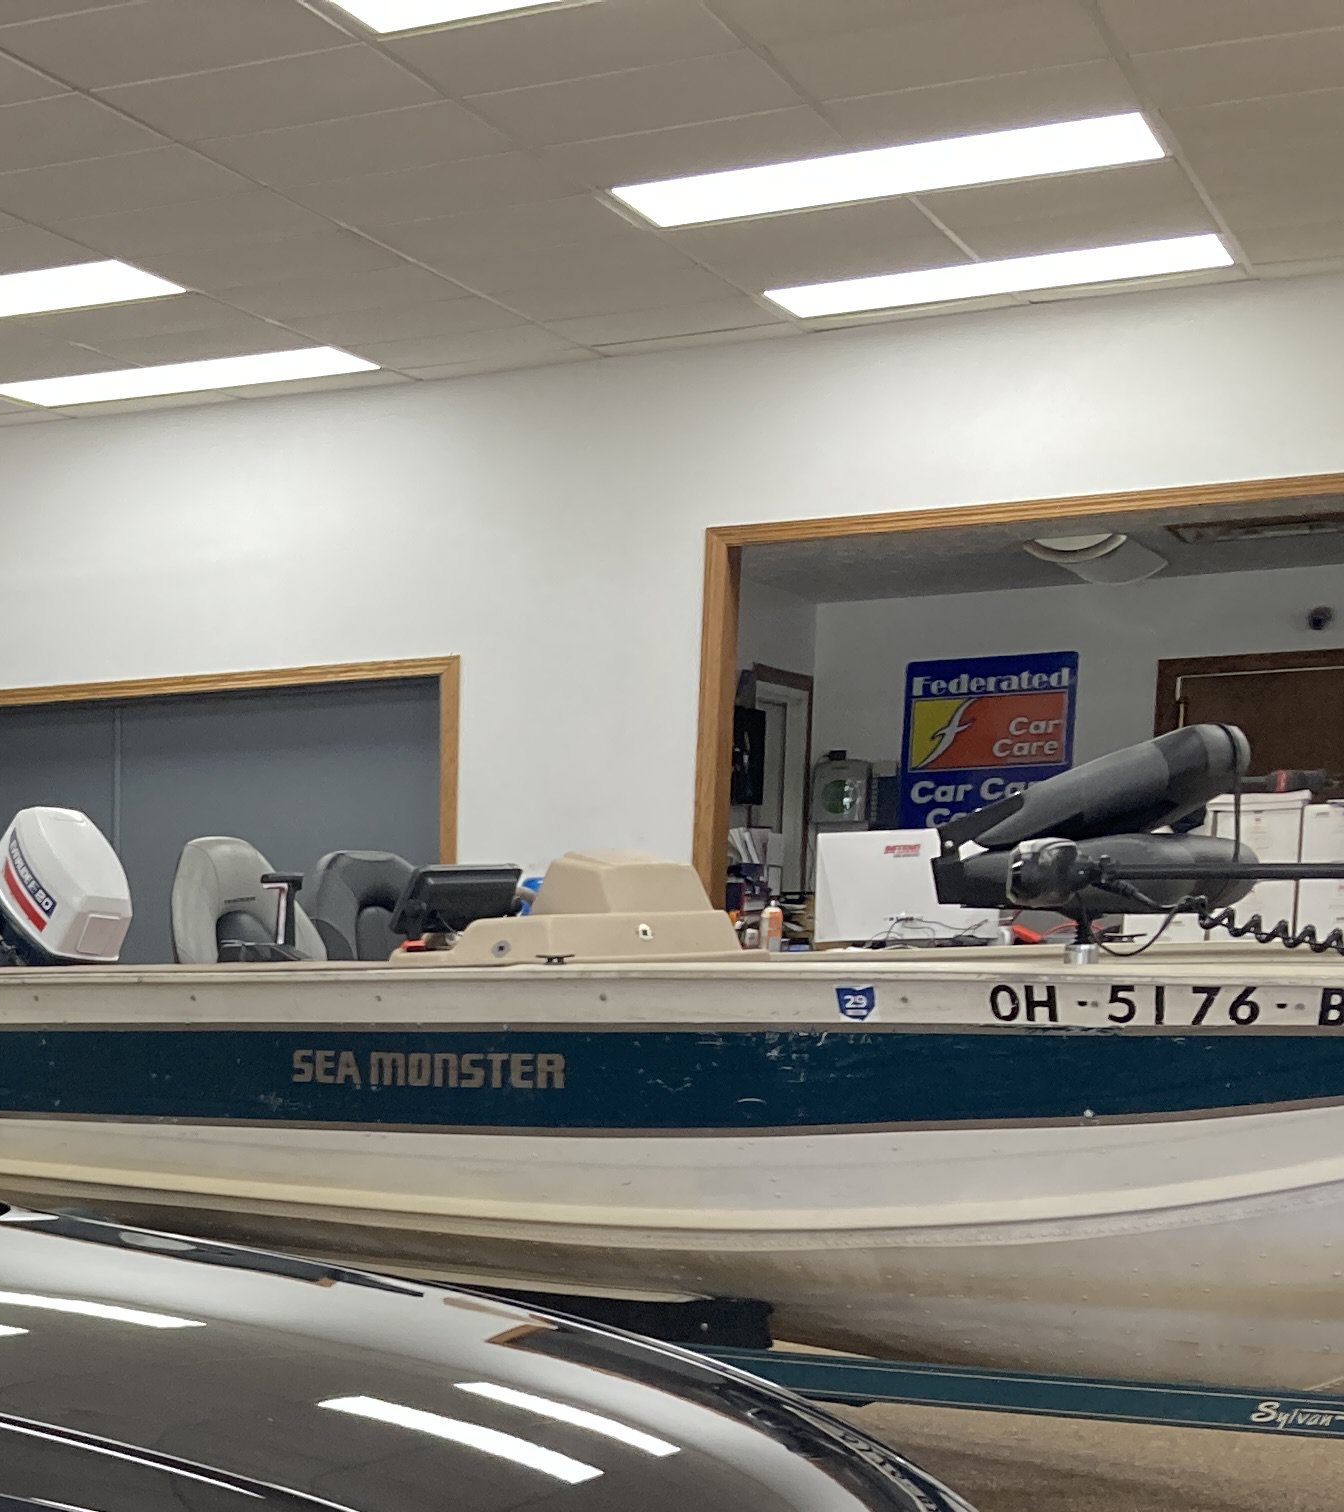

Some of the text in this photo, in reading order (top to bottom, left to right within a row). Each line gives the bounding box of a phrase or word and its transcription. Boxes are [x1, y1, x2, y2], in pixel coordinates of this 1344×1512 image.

[912, 667, 1072, 697] Federated
[1008, 716, 1062, 736] Car
[992, 738, 1060, 758] Care
[910, 777, 1040, 804] Car Ca
[843, 994, 868, 1009] 29
[990, 983, 1059, 1022] OH
[292, 1049, 566, 1090] SEA MONSTER
[1249, 1400, 1334, 1430] Sylvan
